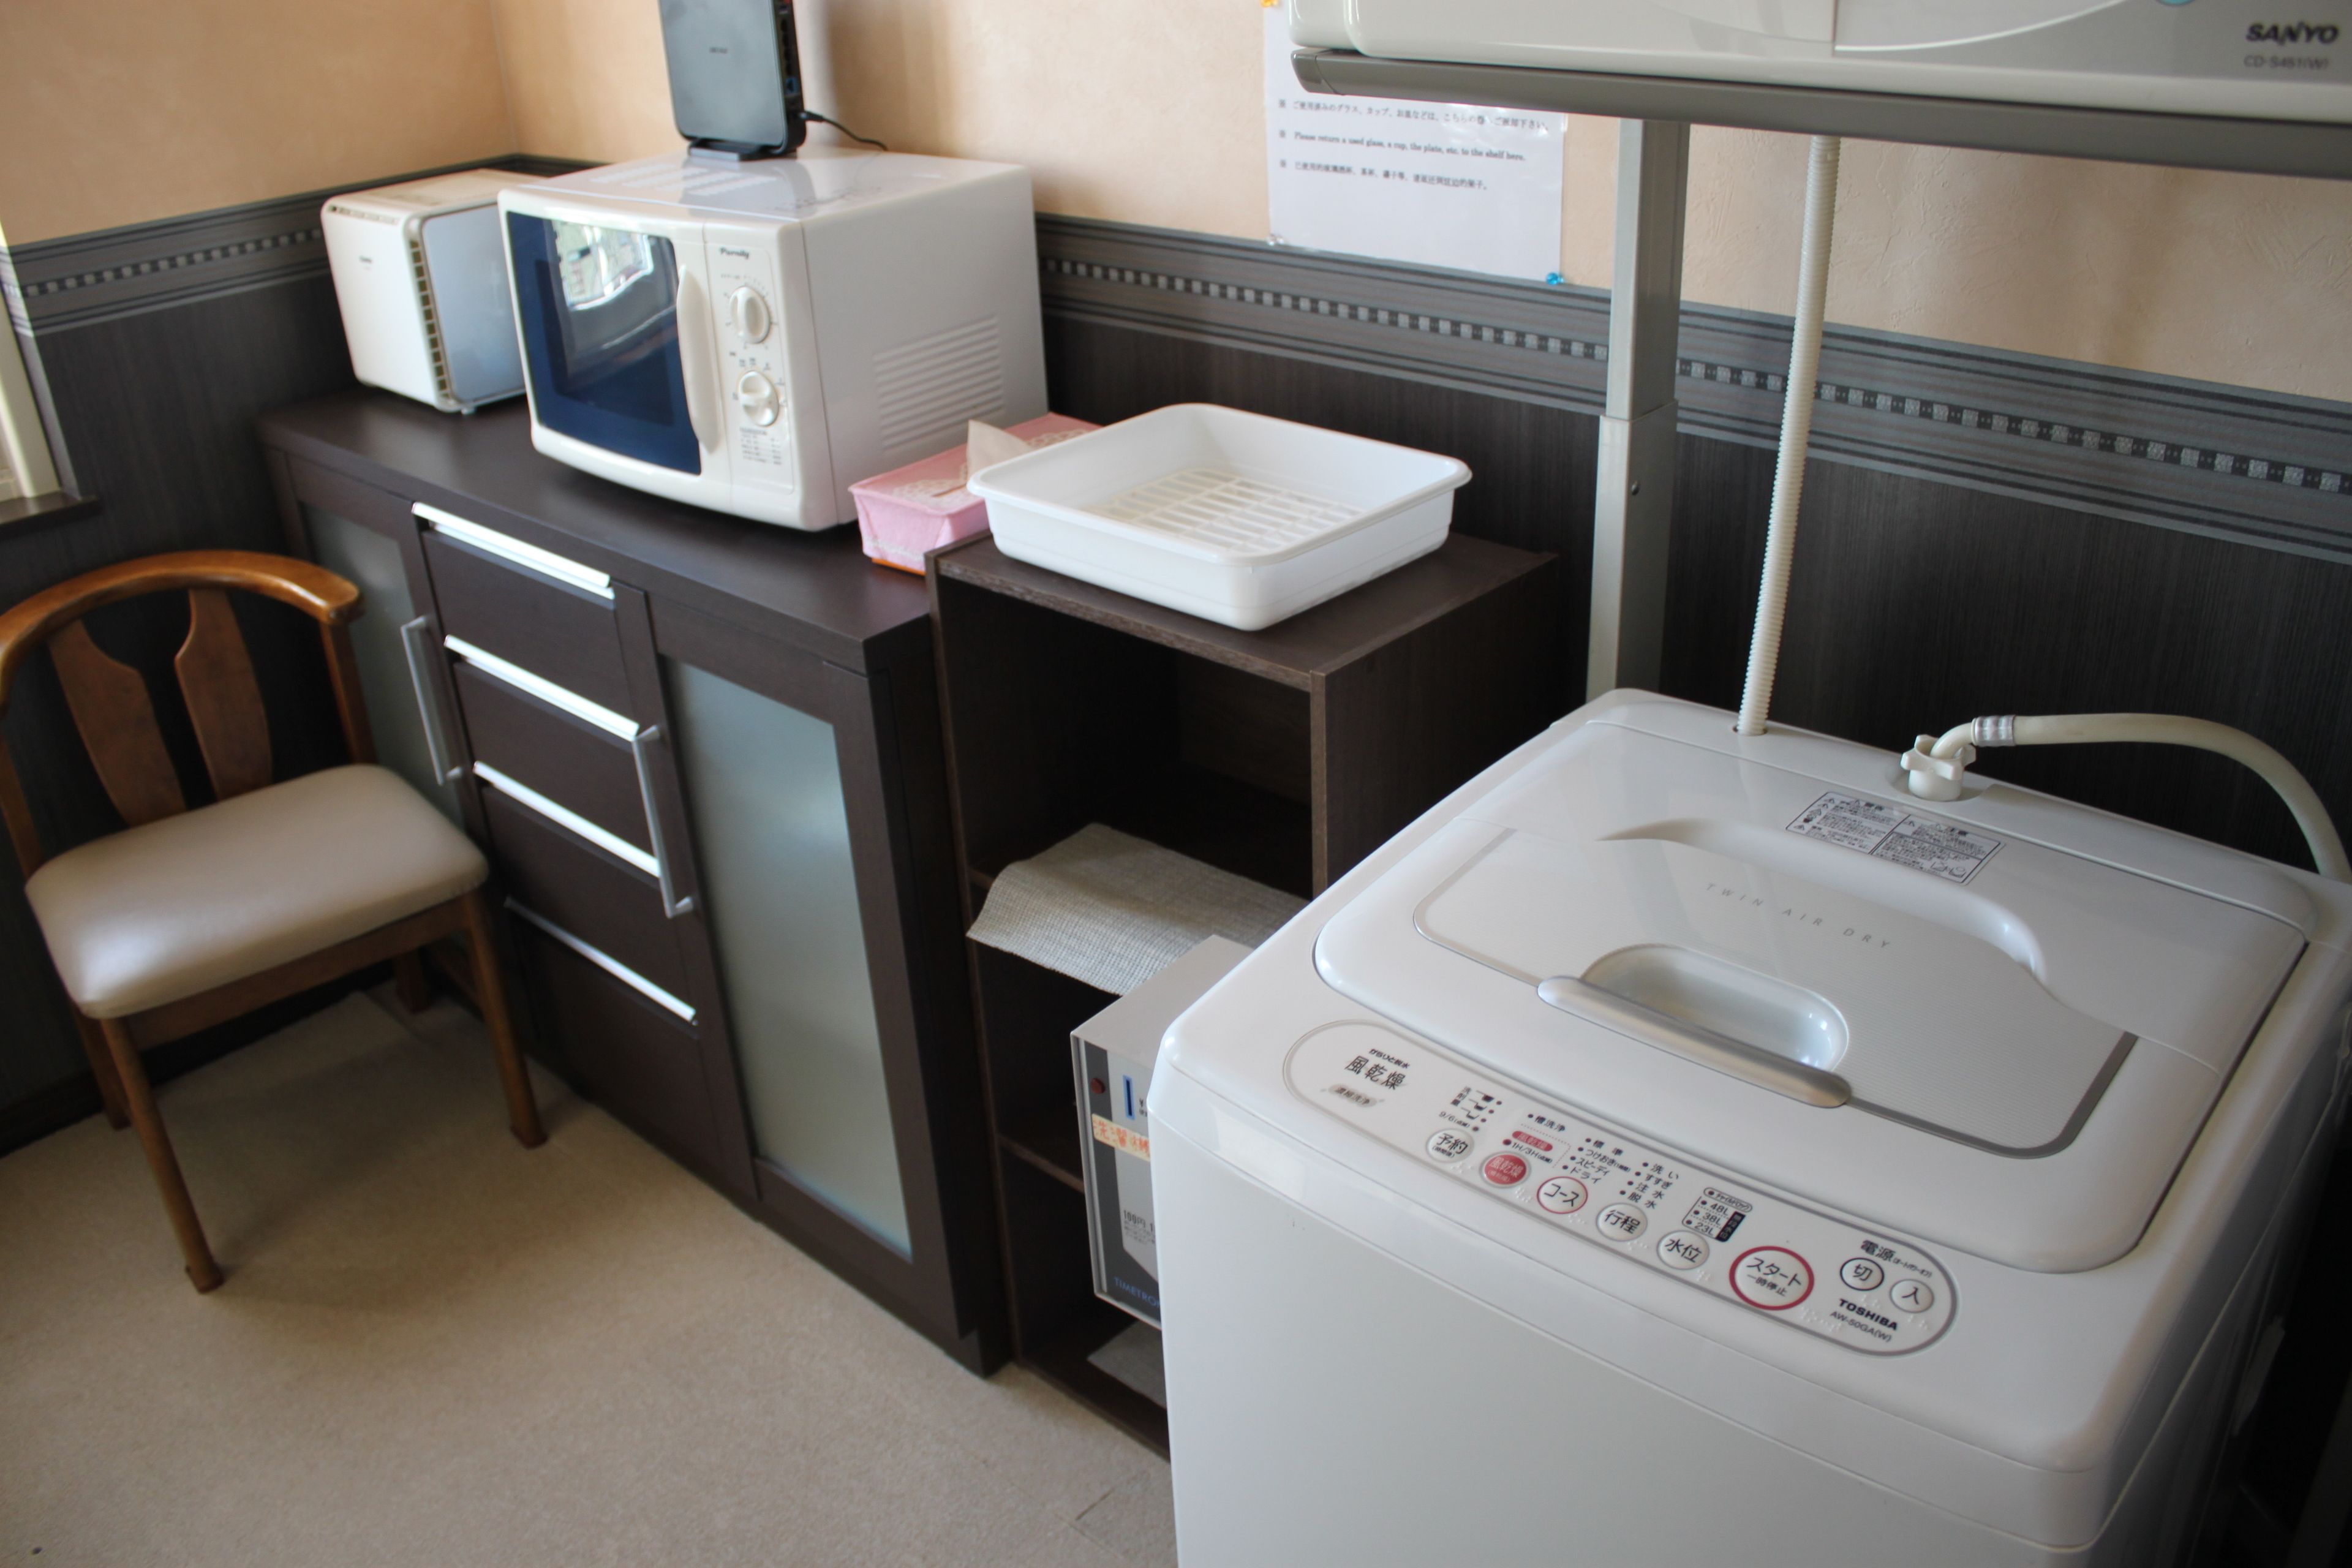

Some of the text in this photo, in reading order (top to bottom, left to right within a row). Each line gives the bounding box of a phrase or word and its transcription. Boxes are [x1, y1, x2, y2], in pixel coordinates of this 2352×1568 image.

[2245, 21, 2339, 46] SANYO
[1294, 131, 1316, 141] Please
[1318, 134, 1340, 143] return
[1349, 137, 1364, 146] used
[1366, 138, 1385, 148] glass,
[1410, 143, 1422, 151] the
[1423, 144, 1444, 154] plate,
[1471, 148, 1483, 157] the
[1485, 149, 1504, 159] shelf
[1506, 152, 1526, 161] here.
[1706, 882, 1890, 949] TWIN AIR DRY
[1344, 1055, 1406, 1090] 風乾燥
[1436, 1133, 1469, 1155] 予約
[1570, 1166, 1602, 1185] ドライ
[1645, 1173, 1673, 1189] すすぎ
[1651, 1163, 1679, 1180] 洗い
[1544, 1183, 1580, 1207] コース
[1627, 1191, 1657, 1210] 脱水
[1635, 1182, 1665, 1200] 注水
[1702, 1213, 1722, 1226] 38L
[1710, 1203, 1730, 1216] 48L
[1604, 1208, 1641, 1234] 行程
[1694, 1222, 1714, 1237] 23L
[1665, 1238, 1702, 1263] 水位
[1860, 1239, 1896, 1262] 電源
[1746, 1256, 1802, 1287] スタート
[1852, 1263, 1874, 1281] 切
[1901, 1286, 1920, 1305] 入
[1839, 1298, 1898, 1331] TOSHIBA
[1829, 1311, 1893, 1343] AW-50GA(W)
